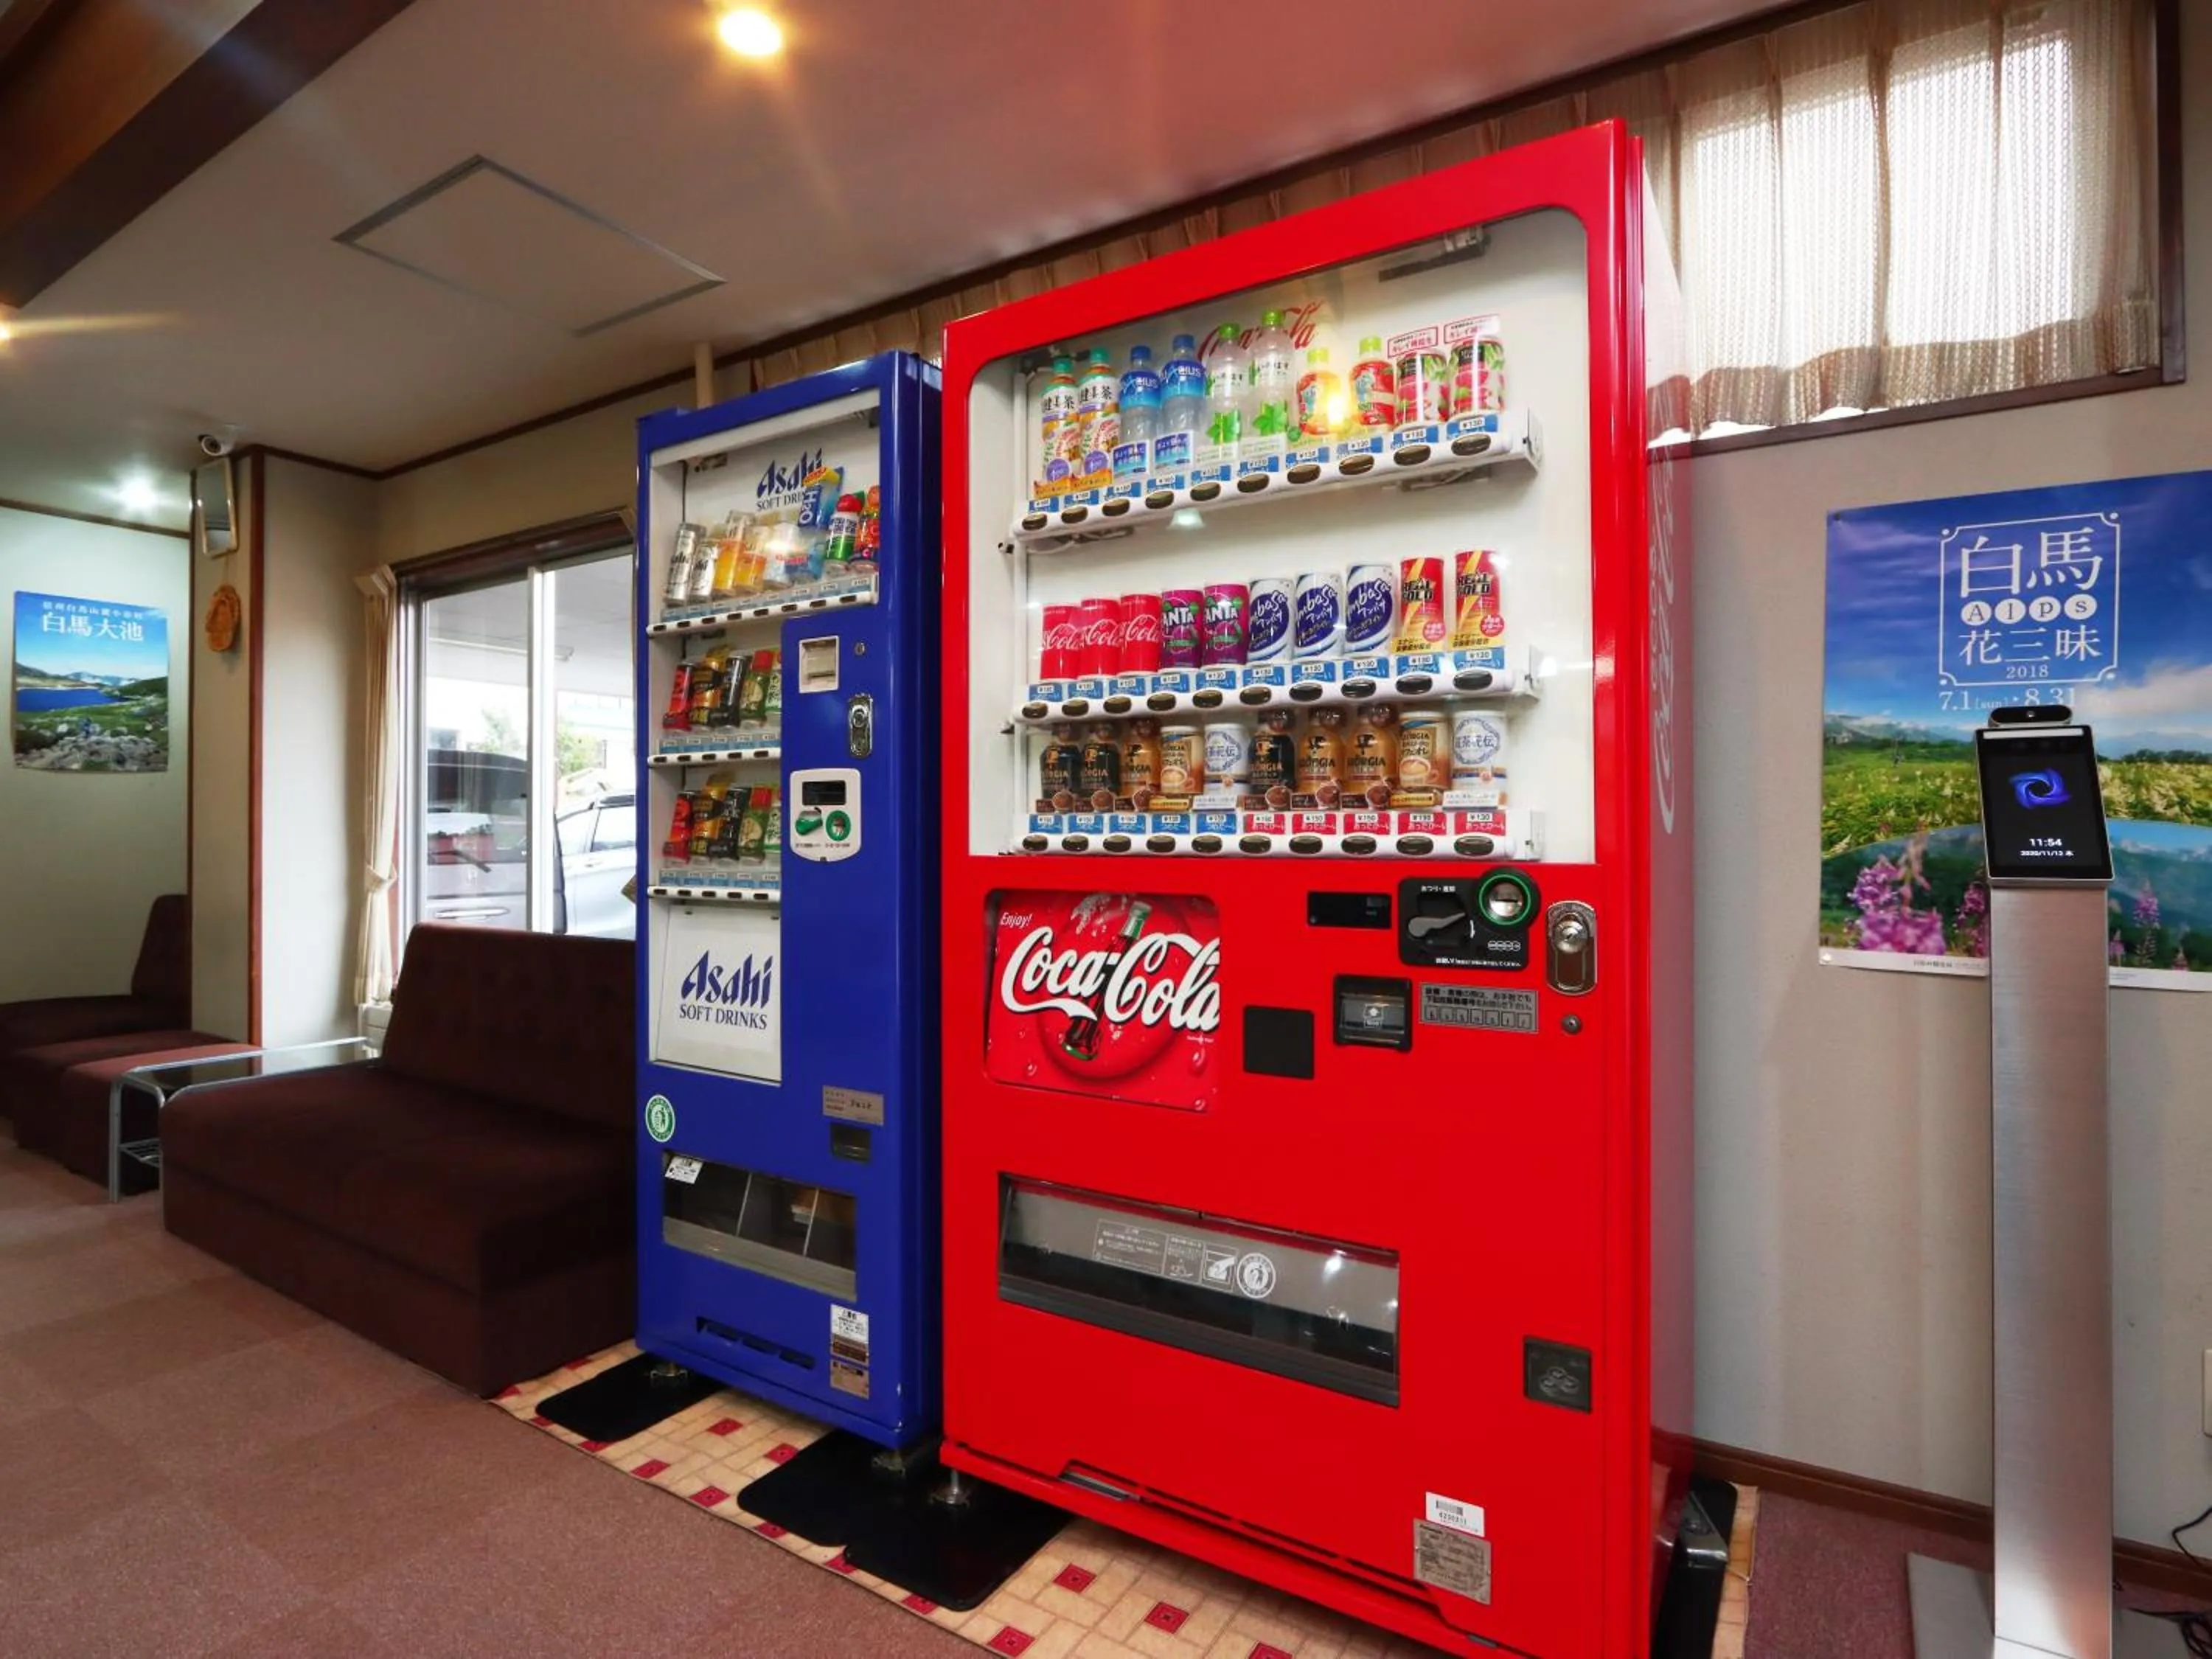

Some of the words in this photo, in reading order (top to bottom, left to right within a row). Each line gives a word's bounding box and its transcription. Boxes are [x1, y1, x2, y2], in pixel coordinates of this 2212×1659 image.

[757, 448, 822, 499] Asahi
[757, 495, 781, 511] SOFT
[1961, 526, 2103, 598] 白馬
[1163, 607, 1195, 626] ANTA
[1204, 602, 1239, 623] ANTA
[1964, 597, 2093, 624] Alps
[42, 611, 144, 641] 白馬大池
[1958, 625, 2101, 665] 花三昧
[2006, 665, 2049, 679] 2018
[2029, 838, 2062, 847] 11:54
[1000, 911, 1034, 928] Enjoy!
[681, 950, 773, 1009] Asahi
[1001, 925, 1220, 1032] Coca-Cola
[679, 1004, 713, 1023] SOFT
[715, 1009, 768, 1030] DRINKS
